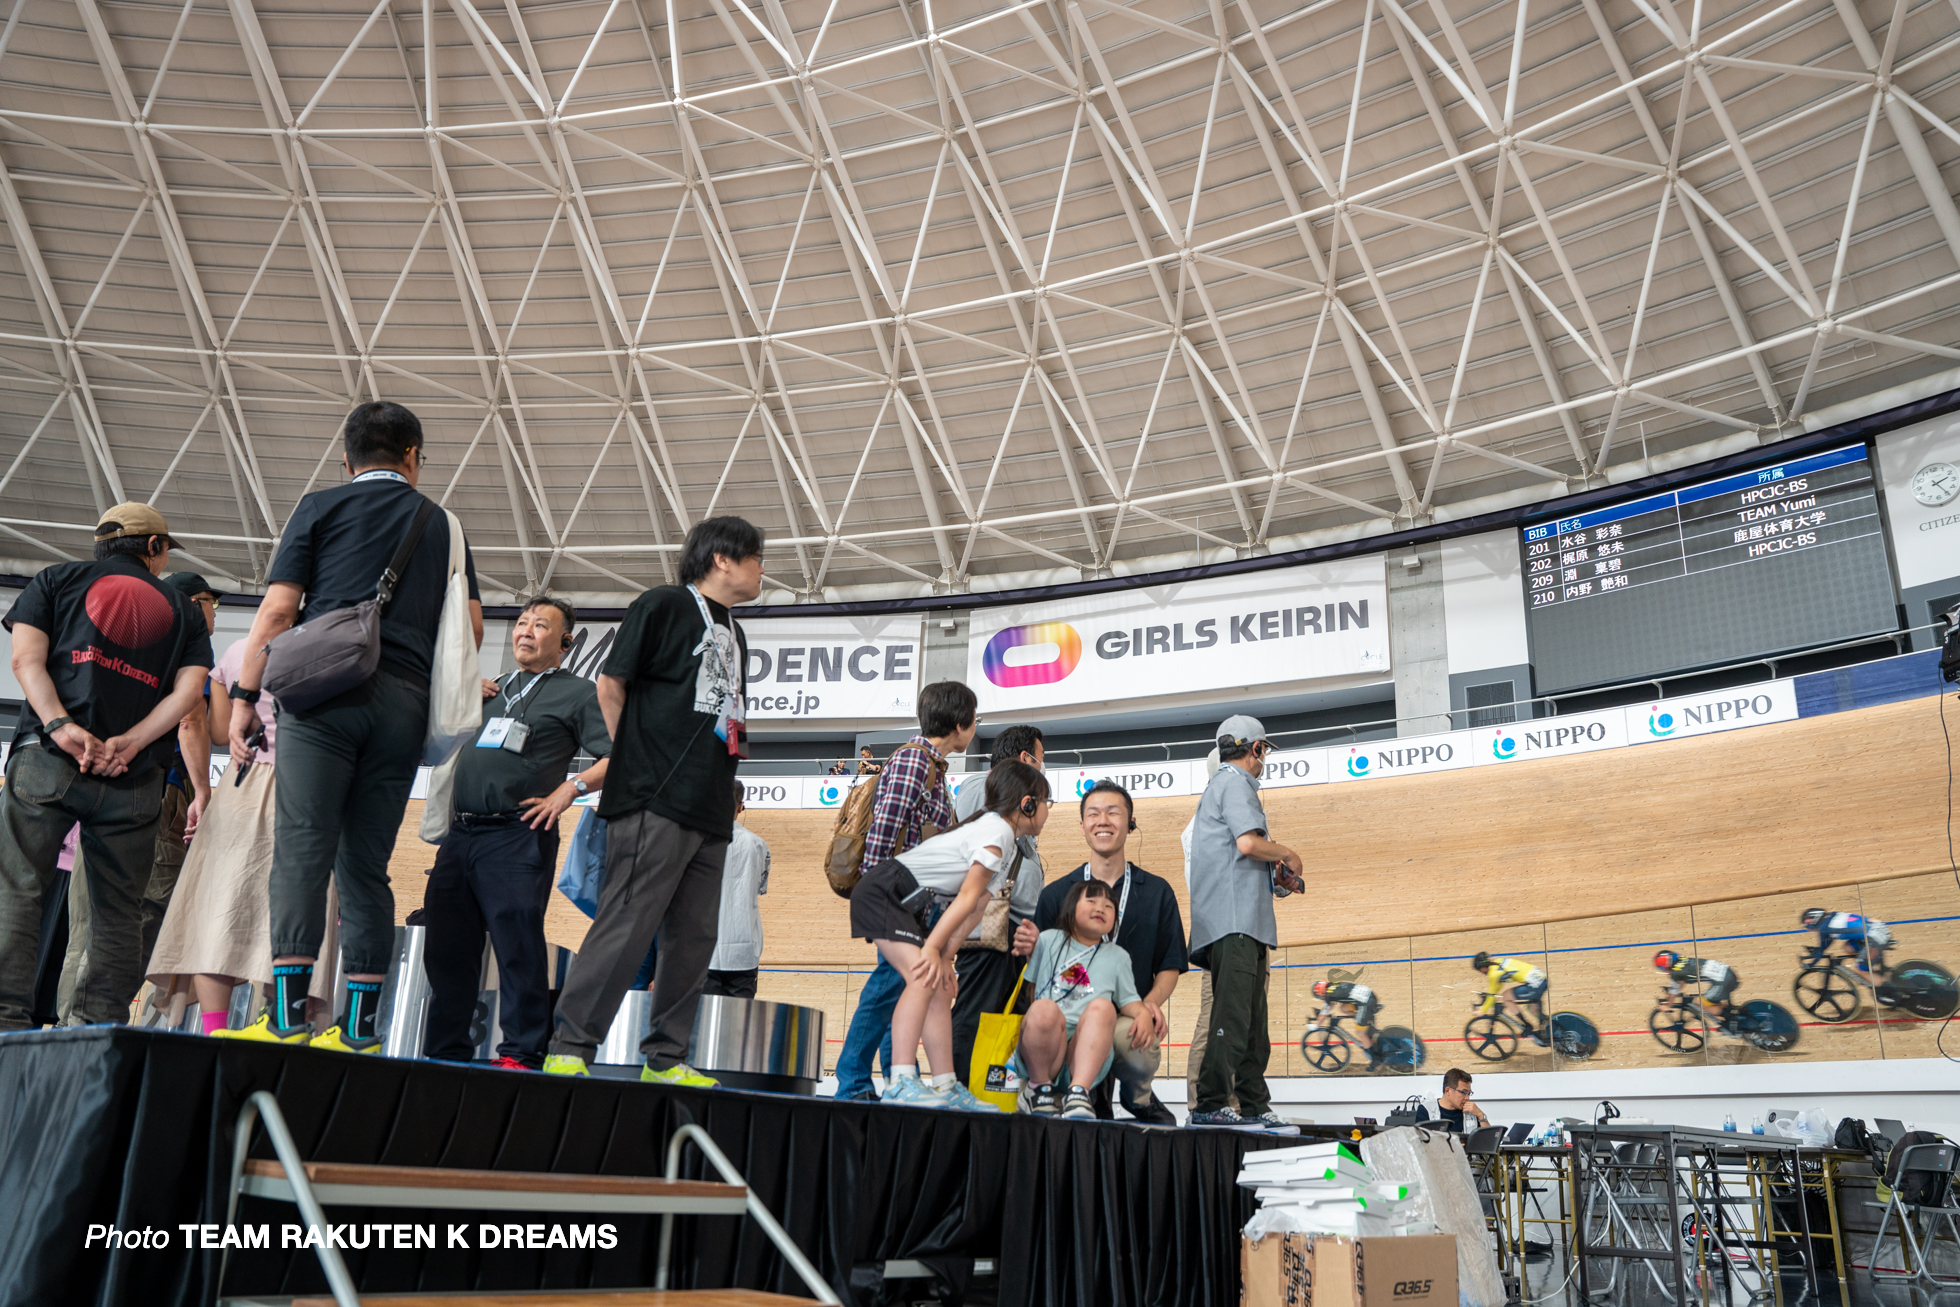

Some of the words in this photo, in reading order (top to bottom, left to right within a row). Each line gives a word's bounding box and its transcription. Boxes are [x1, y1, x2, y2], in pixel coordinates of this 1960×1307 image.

[1528, 527, 1547, 540] BIB
[1560, 519, 1582, 532] 氏名
[1758, 467, 1785, 483] 所属
[1529, 542, 1550, 556] 201
[1562, 533, 1586, 548] 水谷
[1596, 524, 1622, 540] 彩奈
[1741, 479, 1808, 504] HPCJC-BS
[1919, 513, 1960, 531] CITIZE
[1530, 558, 1552, 572] 202
[1563, 549, 1588, 565] 梶原
[1737, 504, 1777, 522] TEAM
[1780, 495, 1816, 512] Yumi
[1532, 574, 1553, 589] 209
[1734, 511, 1826, 543] 鹿屋体育大学
[1533, 591, 1555, 605] 210
[1566, 582, 1592, 599] 内野
[1748, 532, 1817, 557] HPCJC-BS
[1095, 618, 1219, 660] GIRLS
[1230, 599, 1370, 644] KEIRIN
[72, 650, 112, 669] RAKUTEN
[112, 657, 124, 673] K
[121, 663, 160, 689] DREAMS
[1683, 694, 1773, 727] NIPPO
[1377, 743, 1454, 769] NIPPO
[1525, 722, 1606, 751] NIPPO
[745, 785, 787, 802] PPO
[1393, 1279, 1432, 1296] Q36.5
